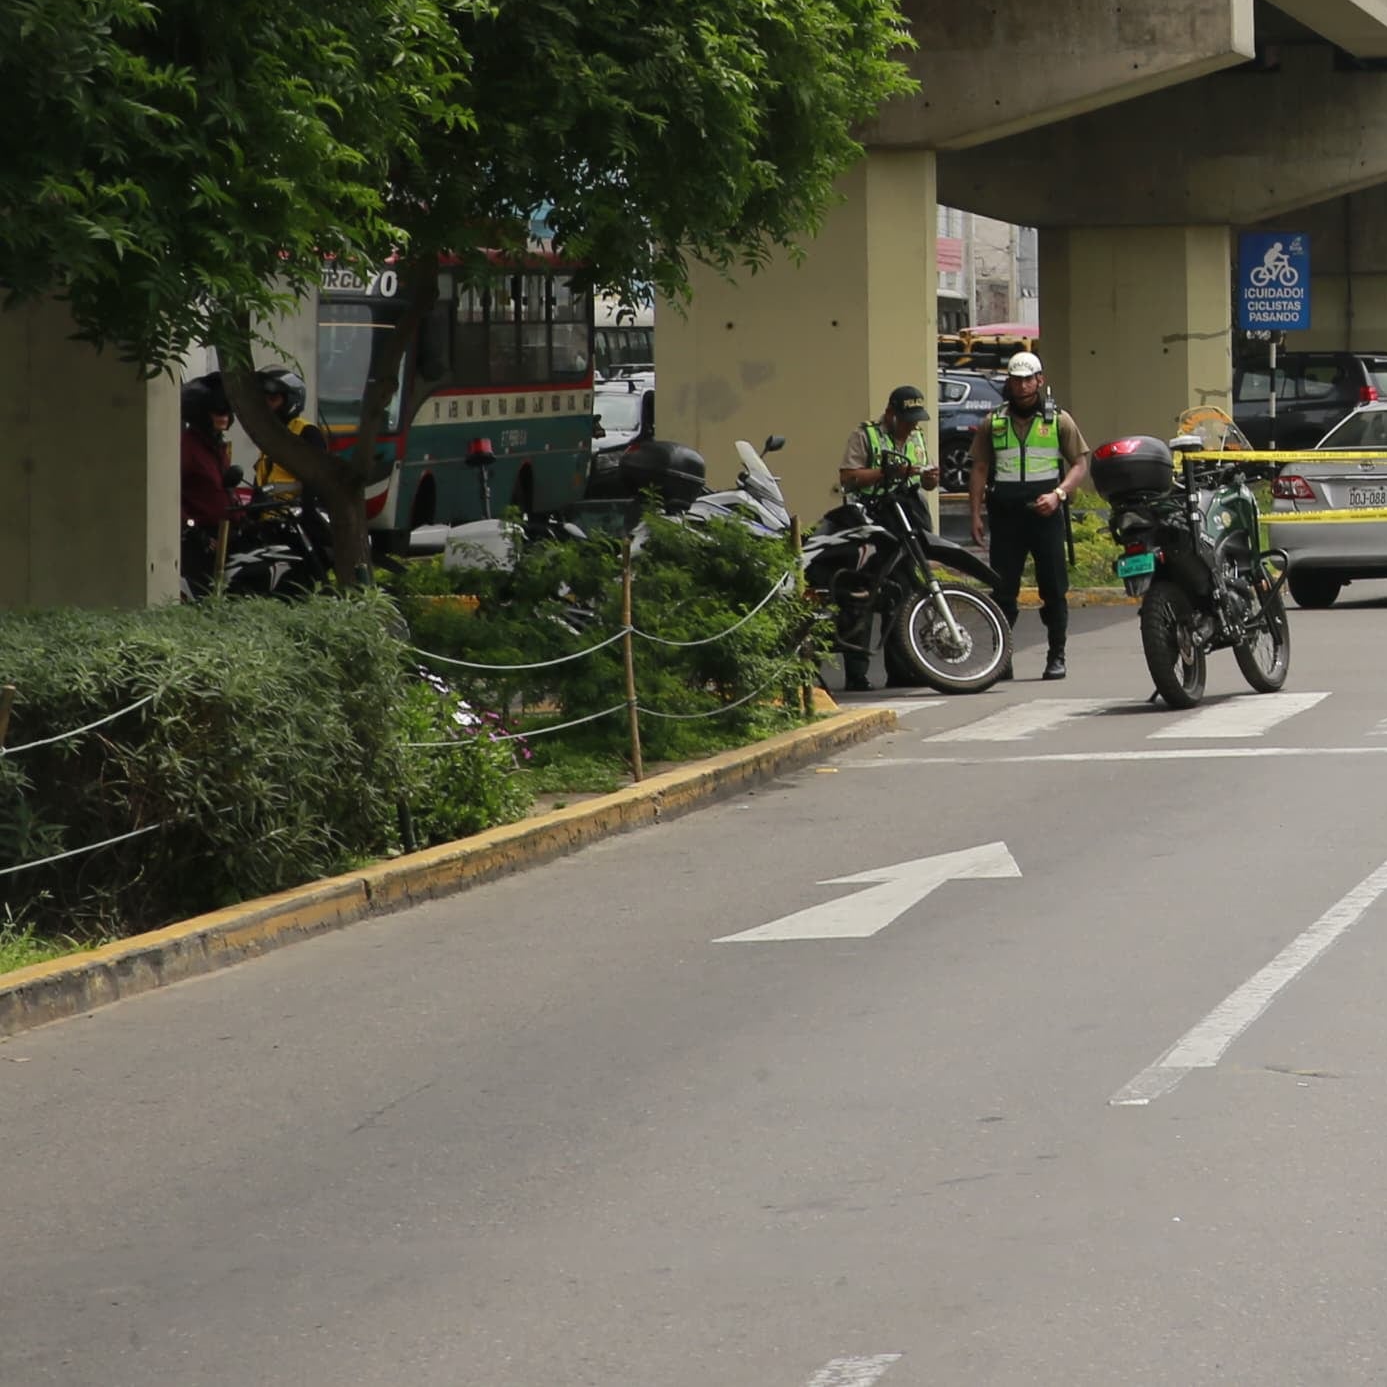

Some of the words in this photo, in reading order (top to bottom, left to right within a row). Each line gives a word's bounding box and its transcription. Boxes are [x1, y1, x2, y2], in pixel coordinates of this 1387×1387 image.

[365, 269, 398, 297] 70
[1244, 287, 1304, 299] ¡CUIDADO!
[1247, 300, 1302, 311] CICLISTAS
[1249, 312, 1300, 322] PASANDO
